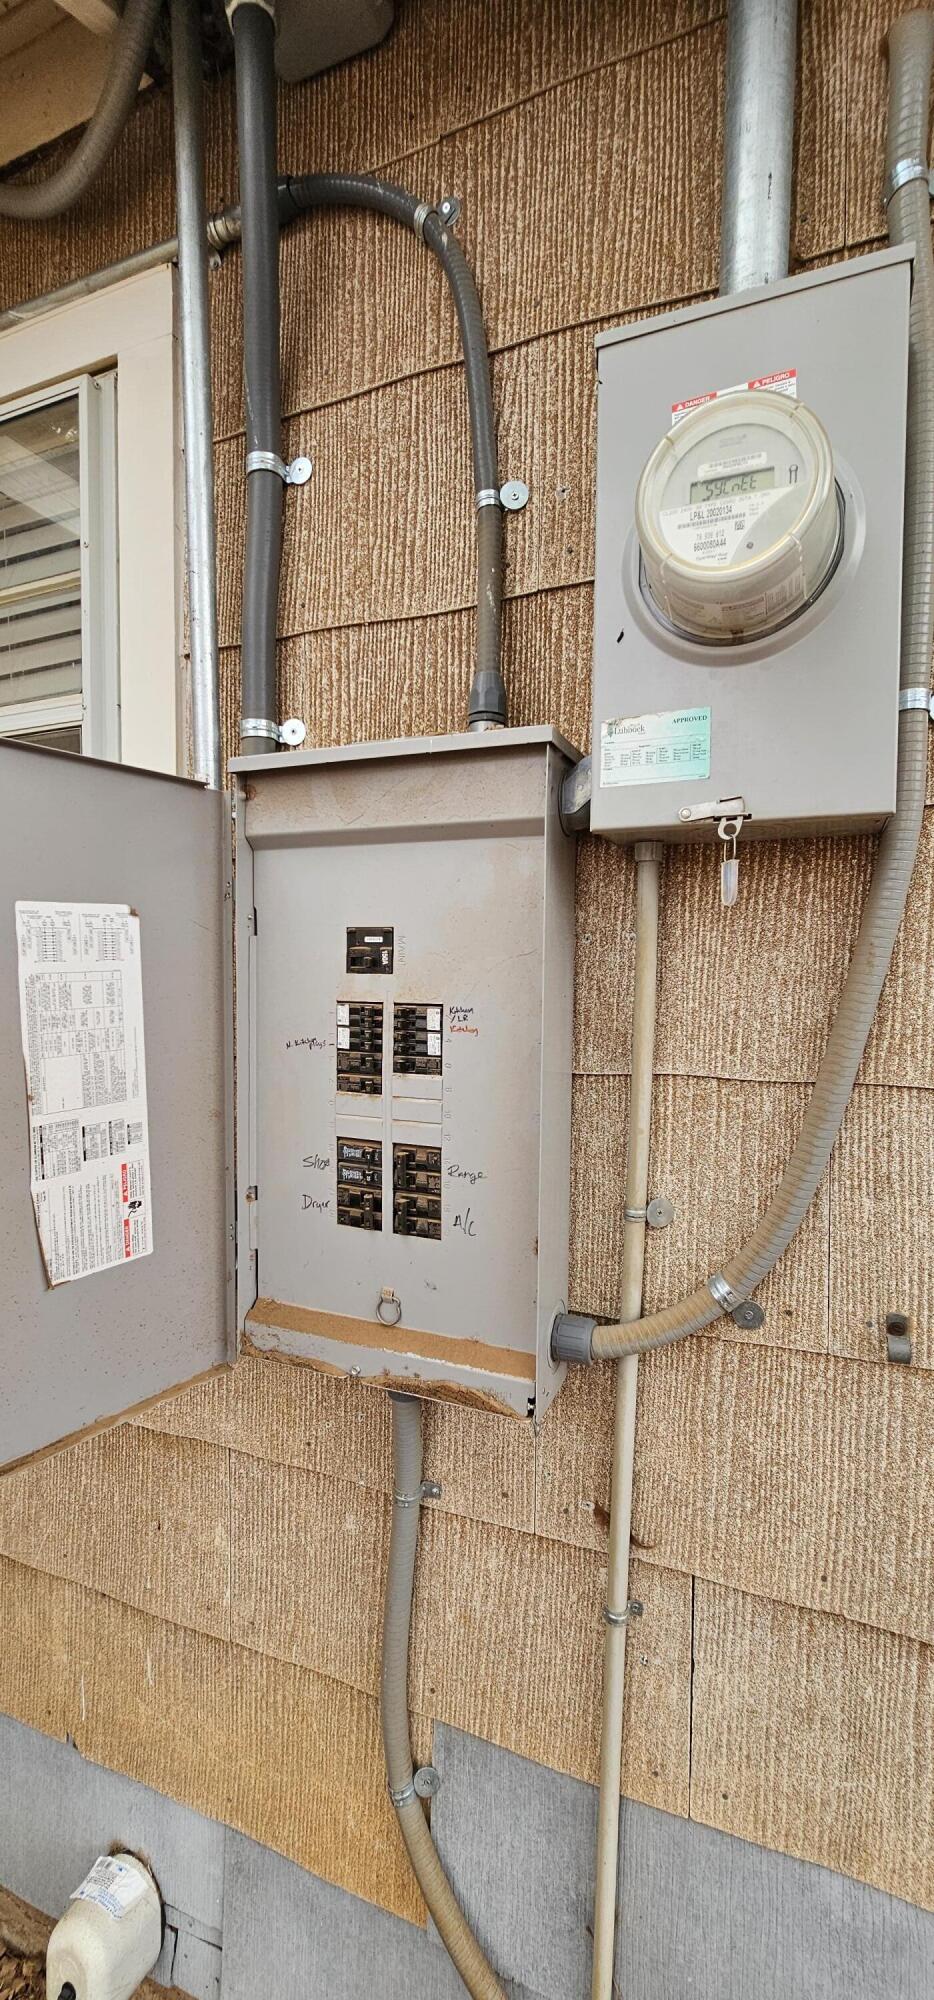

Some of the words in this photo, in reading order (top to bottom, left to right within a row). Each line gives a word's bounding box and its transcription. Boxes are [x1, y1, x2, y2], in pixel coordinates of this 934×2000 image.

[761, 371, 790, 386] PELIGRO
[685, 395, 710, 407] DANGER
[690, 509, 705, 521] LP&L
[672, 714, 708, 724] APPROVED
[614, 723, 646, 735] Lubbock
[381, 950, 389, 965] 150A
[447, 1164, 488, 1185] Range
[301, 1193, 331, 1214] Dryer
[452, 1207, 477, 1237] A/C
